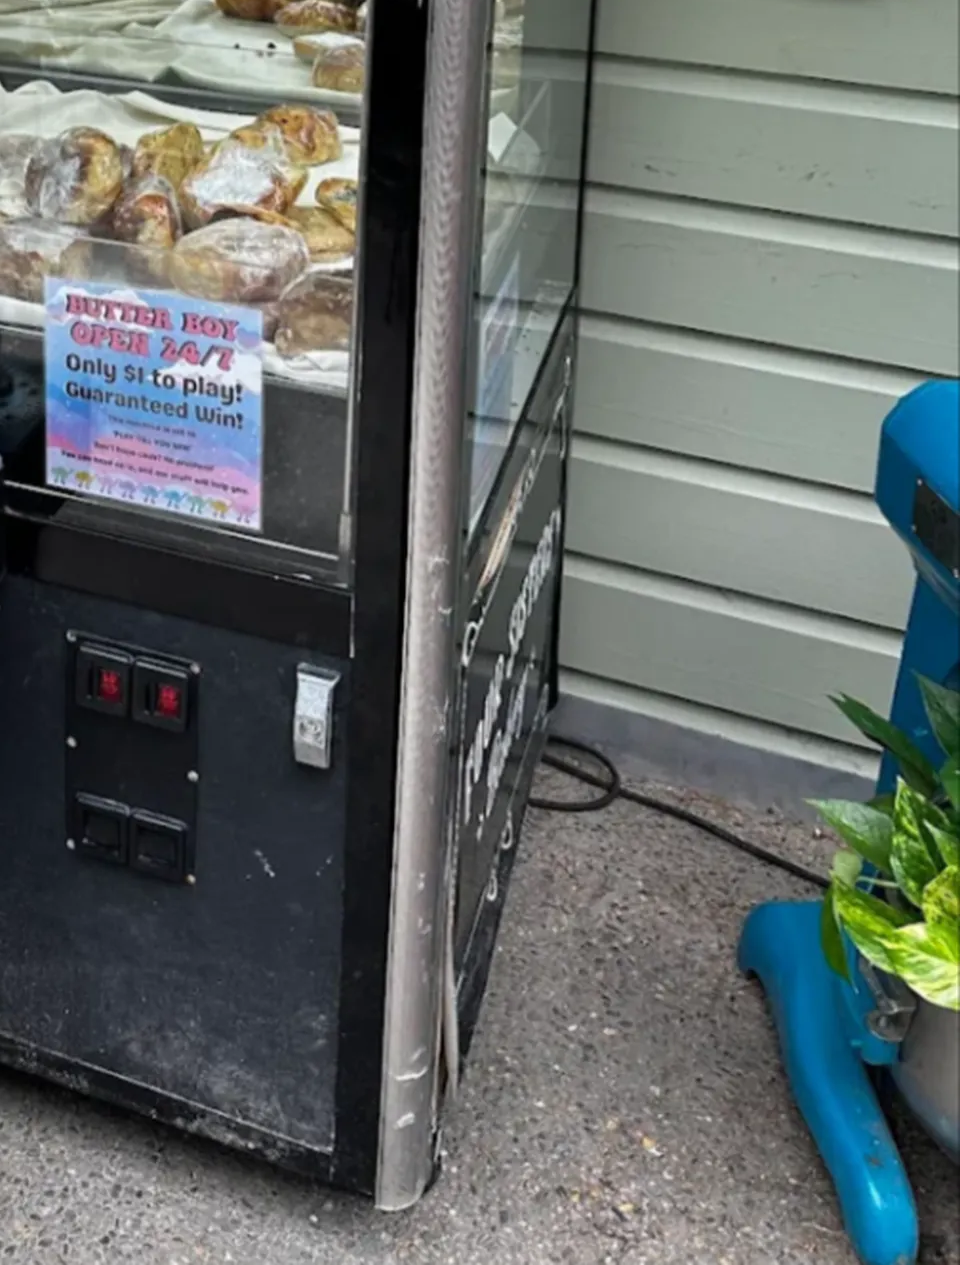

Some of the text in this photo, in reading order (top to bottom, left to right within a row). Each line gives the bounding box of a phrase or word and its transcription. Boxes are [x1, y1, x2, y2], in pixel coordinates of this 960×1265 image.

[66, 294, 239, 342] BUTTER BOY
[71, 321, 235, 371] OPEN 24/7
[66, 353, 244, 406] Only $1 to play!
[66, 381, 244, 430] Guaranteed Win!
